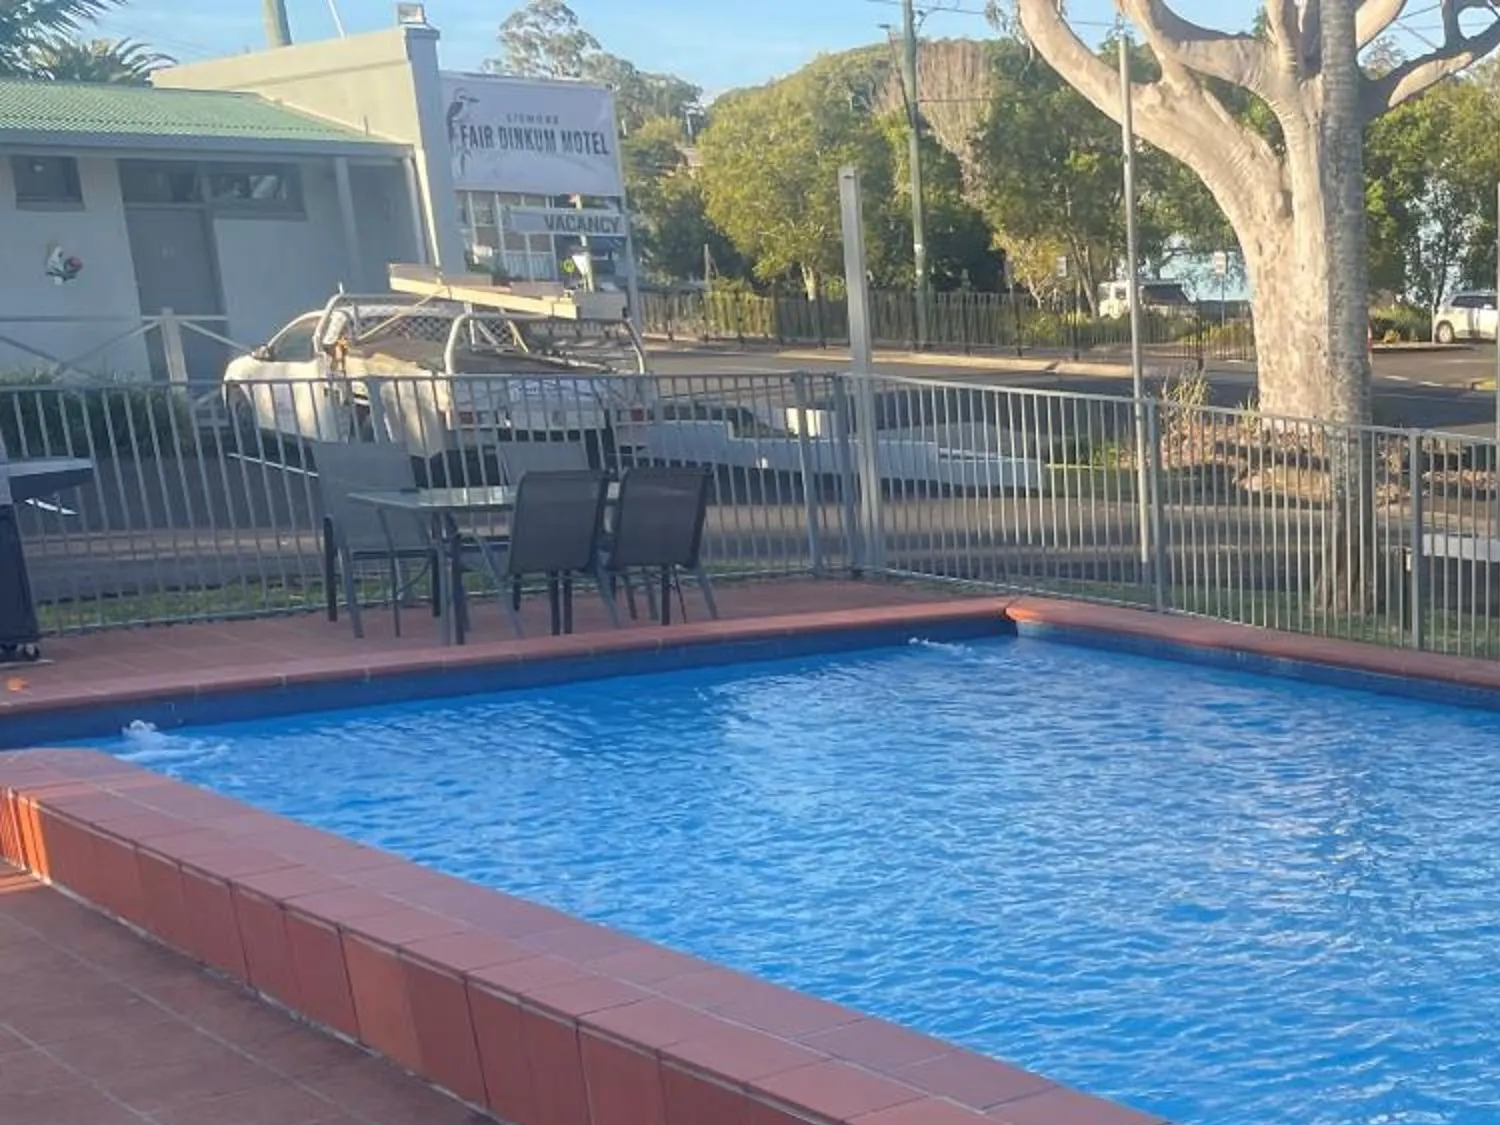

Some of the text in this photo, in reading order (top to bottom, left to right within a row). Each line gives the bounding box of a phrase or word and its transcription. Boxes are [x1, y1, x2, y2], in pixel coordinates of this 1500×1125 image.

[459, 125, 610, 156] FAIR DINKUM MOTEL
[544, 213, 621, 234] VACANCY
